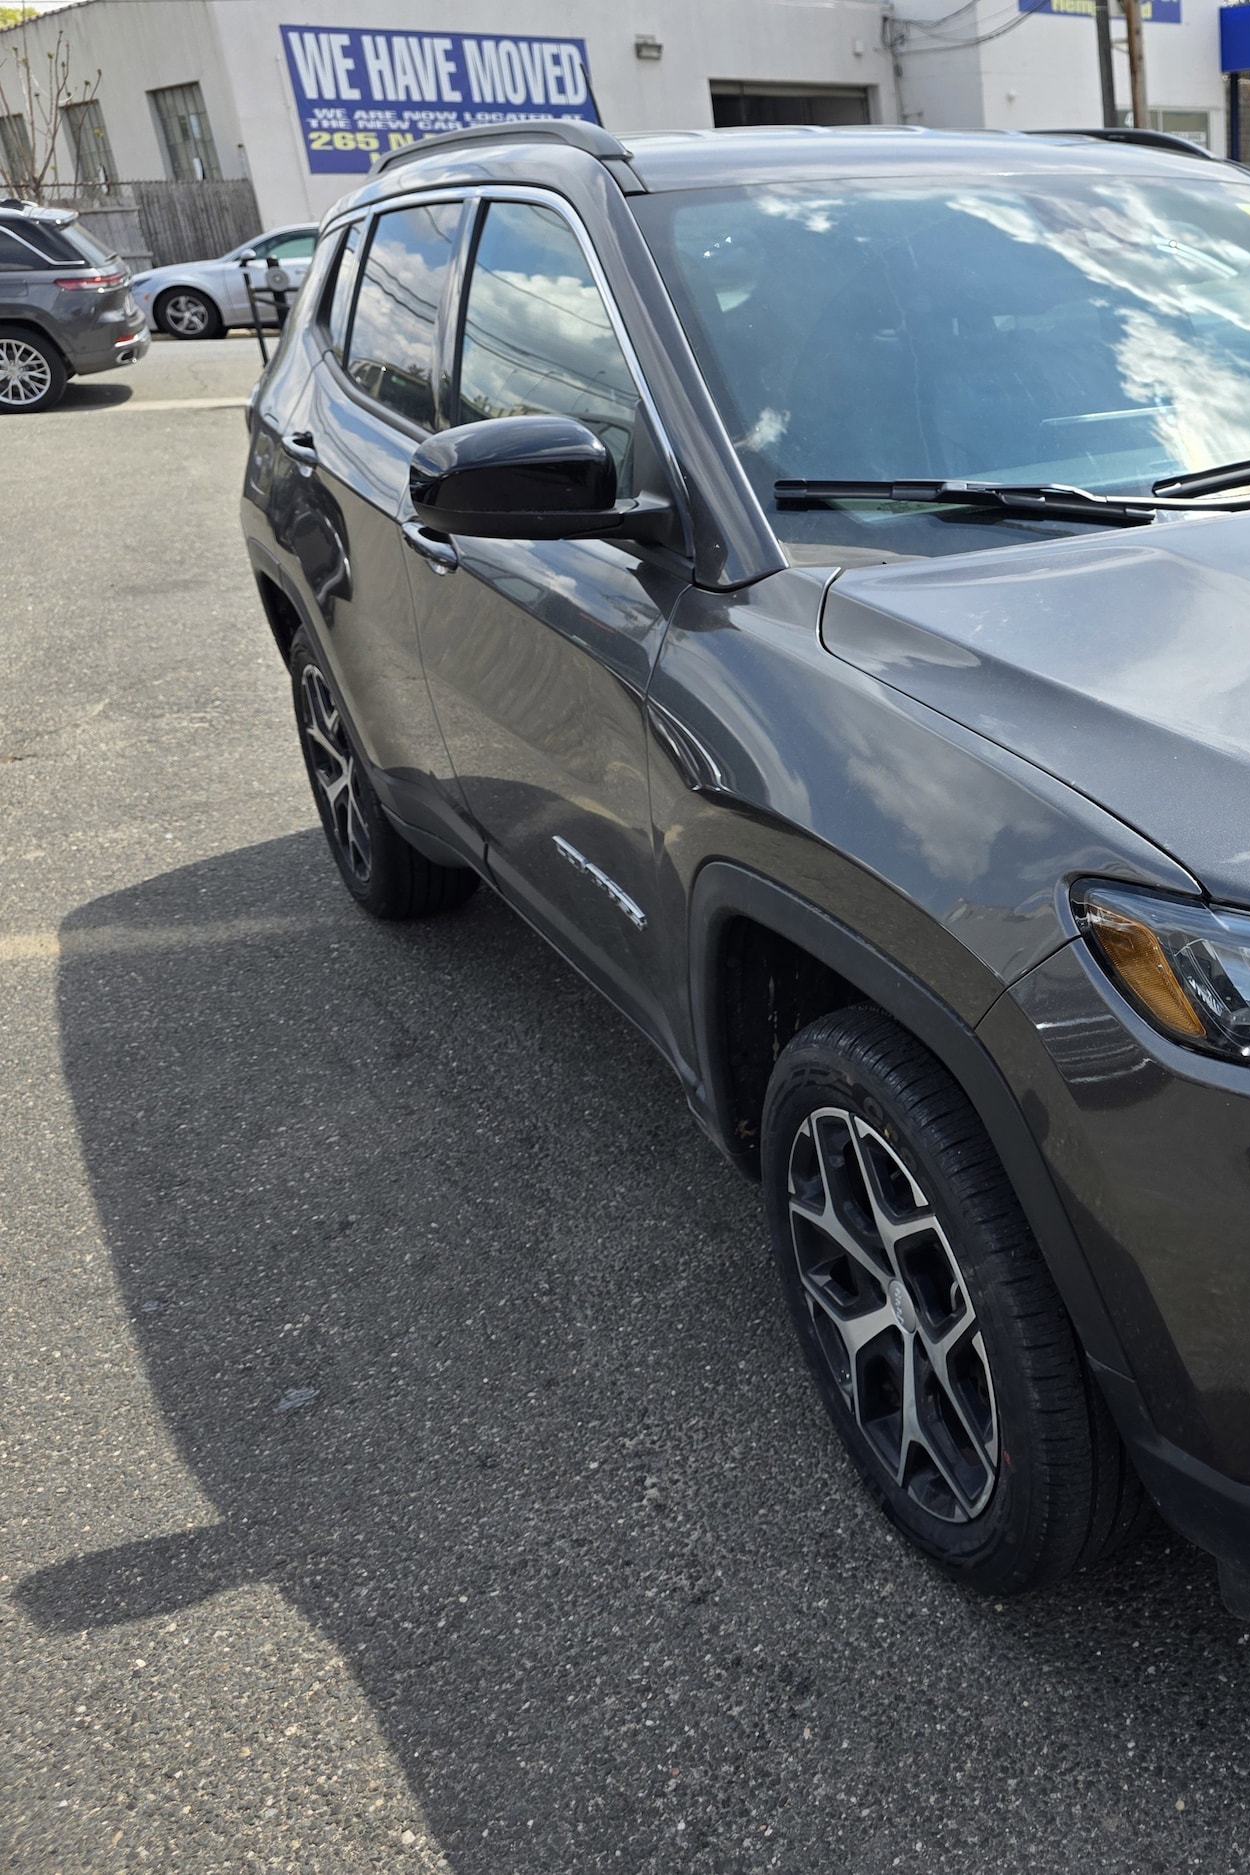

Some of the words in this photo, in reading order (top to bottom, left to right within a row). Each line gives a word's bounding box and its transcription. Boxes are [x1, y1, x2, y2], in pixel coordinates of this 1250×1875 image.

[288, 32, 361, 100] WE
[361, 35, 463, 103] HAVE
[462, 39, 588, 106] MOVED
[312, 108, 348, 119] WE
[353, 110, 397, 120] ARE
[402, 111, 458, 121] NOW
[463, 111, 553, 122] LOCATED
[306, 118, 350, 129] THE
[357, 120, 411, 130] NEW
[417, 121, 463, 131] CAR
[309, 131, 380, 151] 265
